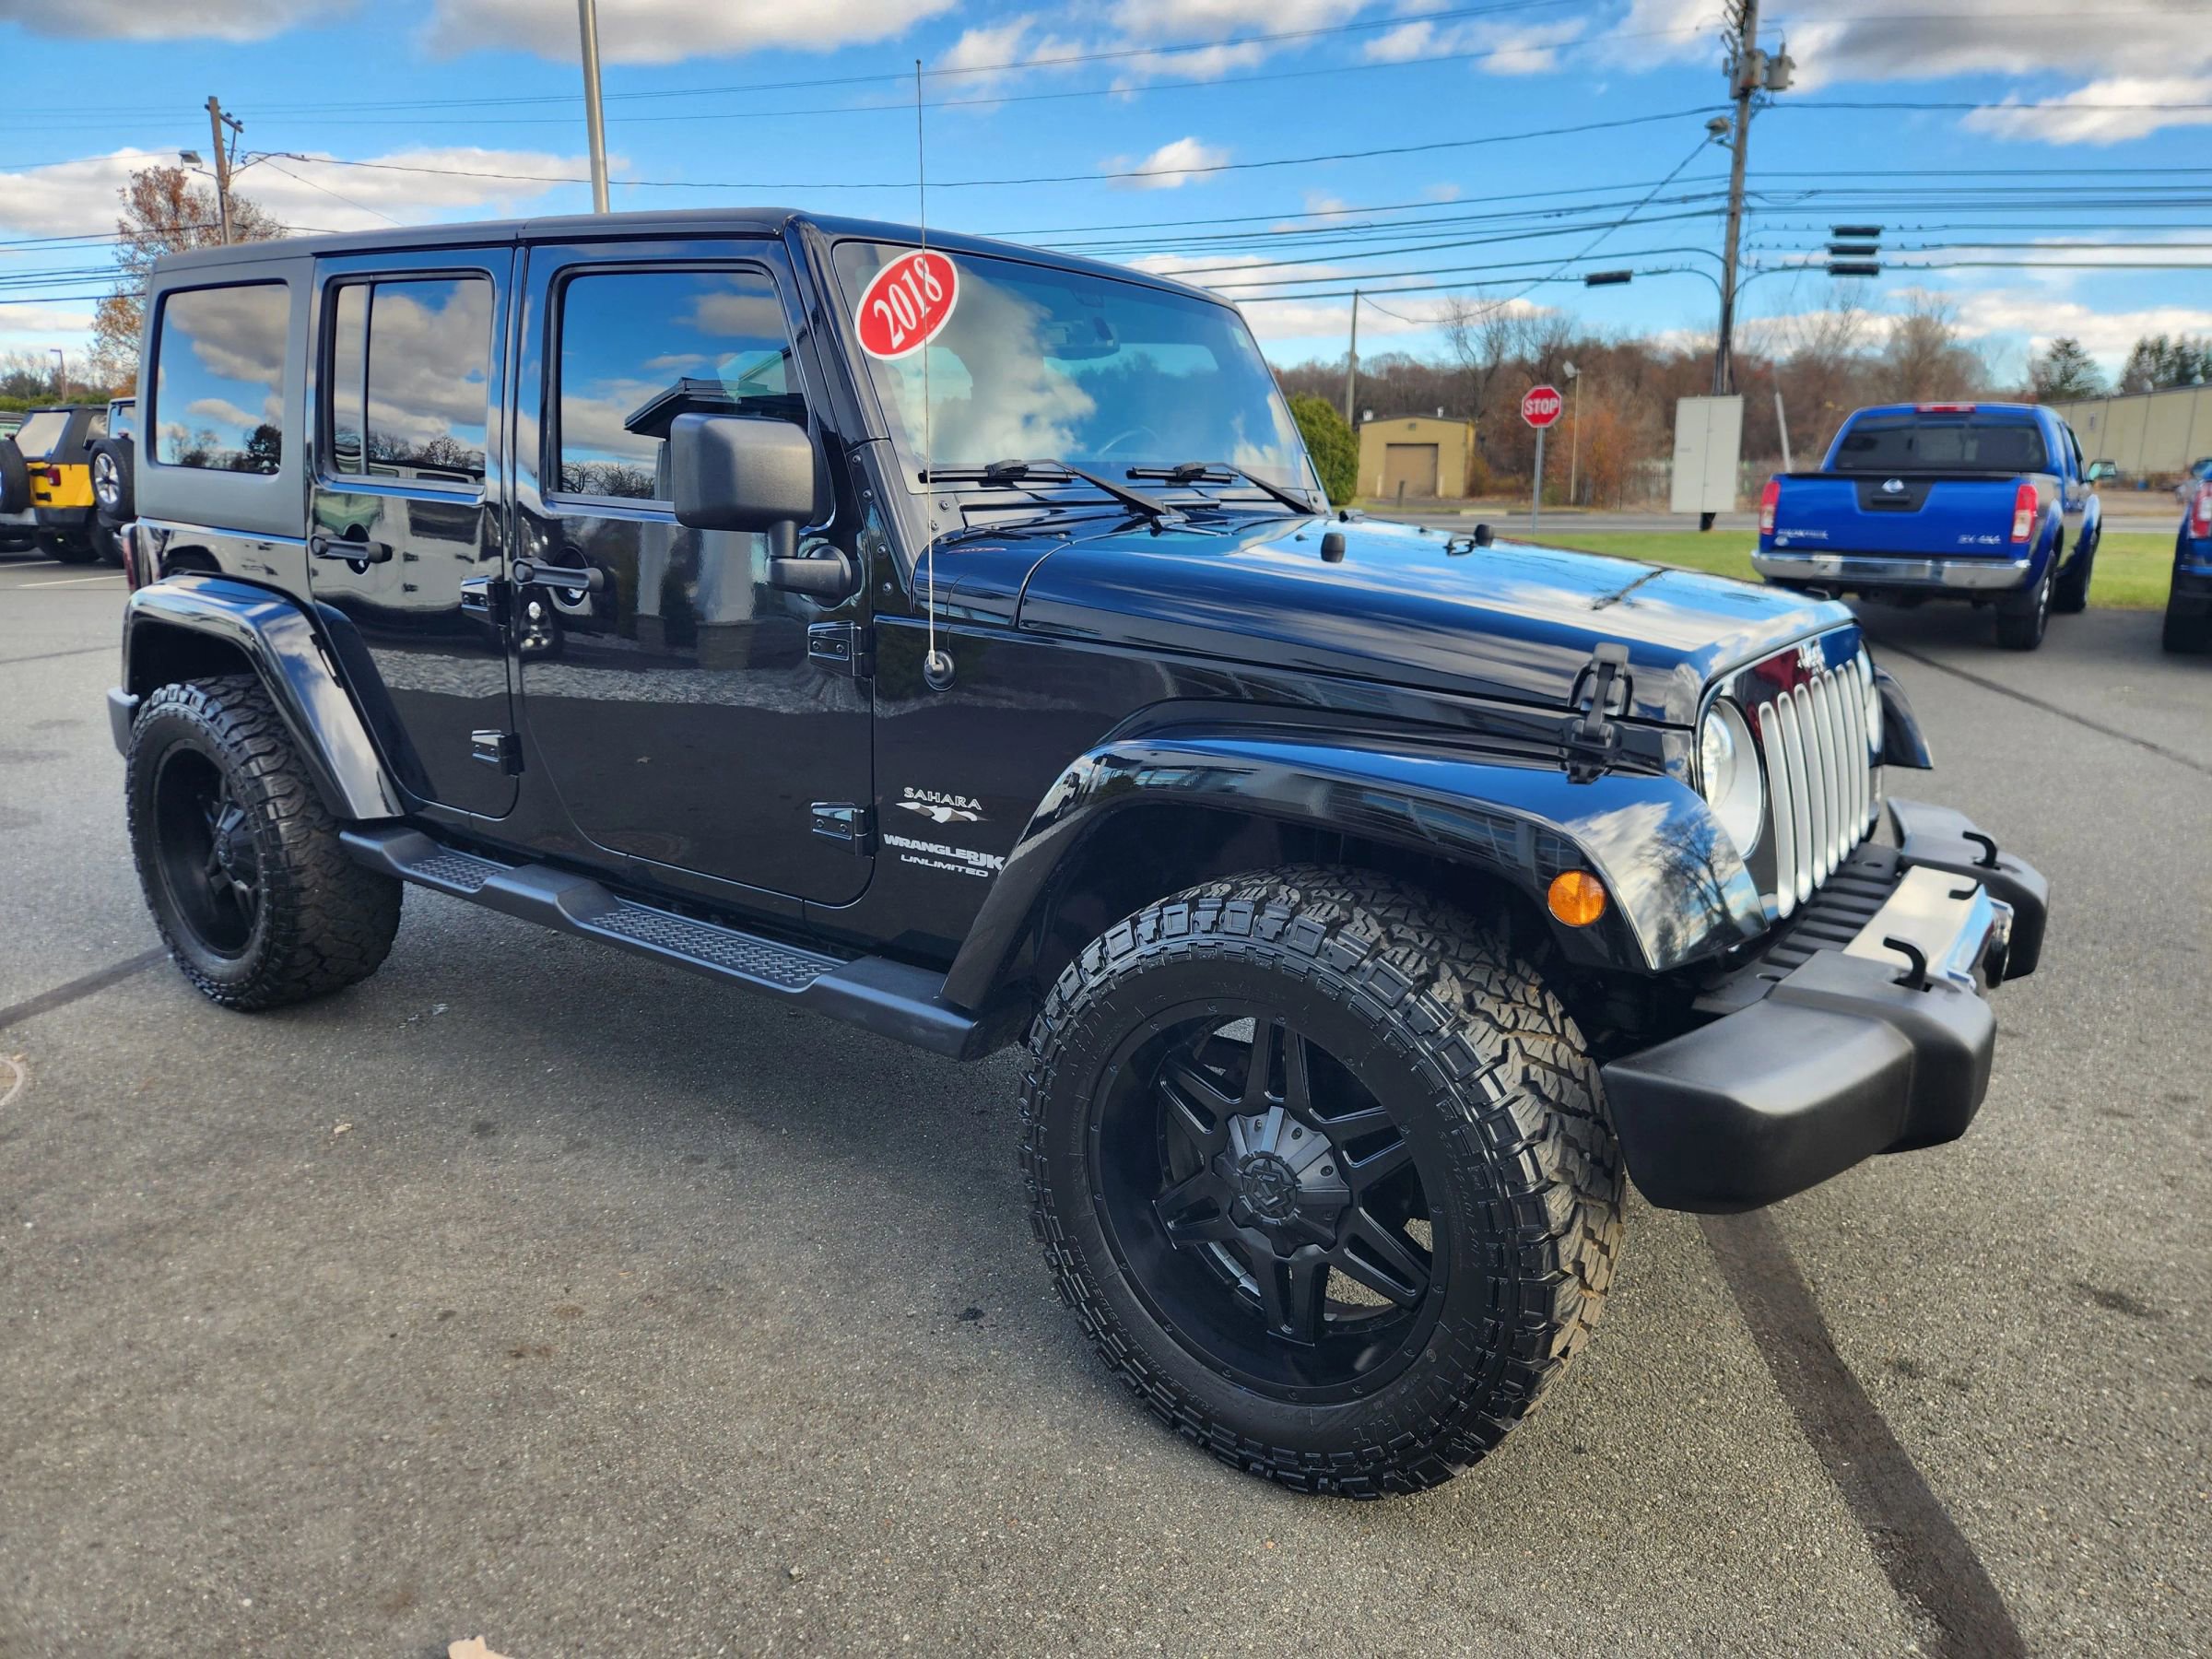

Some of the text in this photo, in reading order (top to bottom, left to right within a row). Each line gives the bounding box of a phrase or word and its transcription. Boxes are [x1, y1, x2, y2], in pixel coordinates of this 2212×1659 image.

[873, 257, 943, 349] 2018
[1524, 397, 1559, 416] STOP
[903, 787, 982, 810] SAHARA
[900, 853, 989, 877] UNLIMITED
